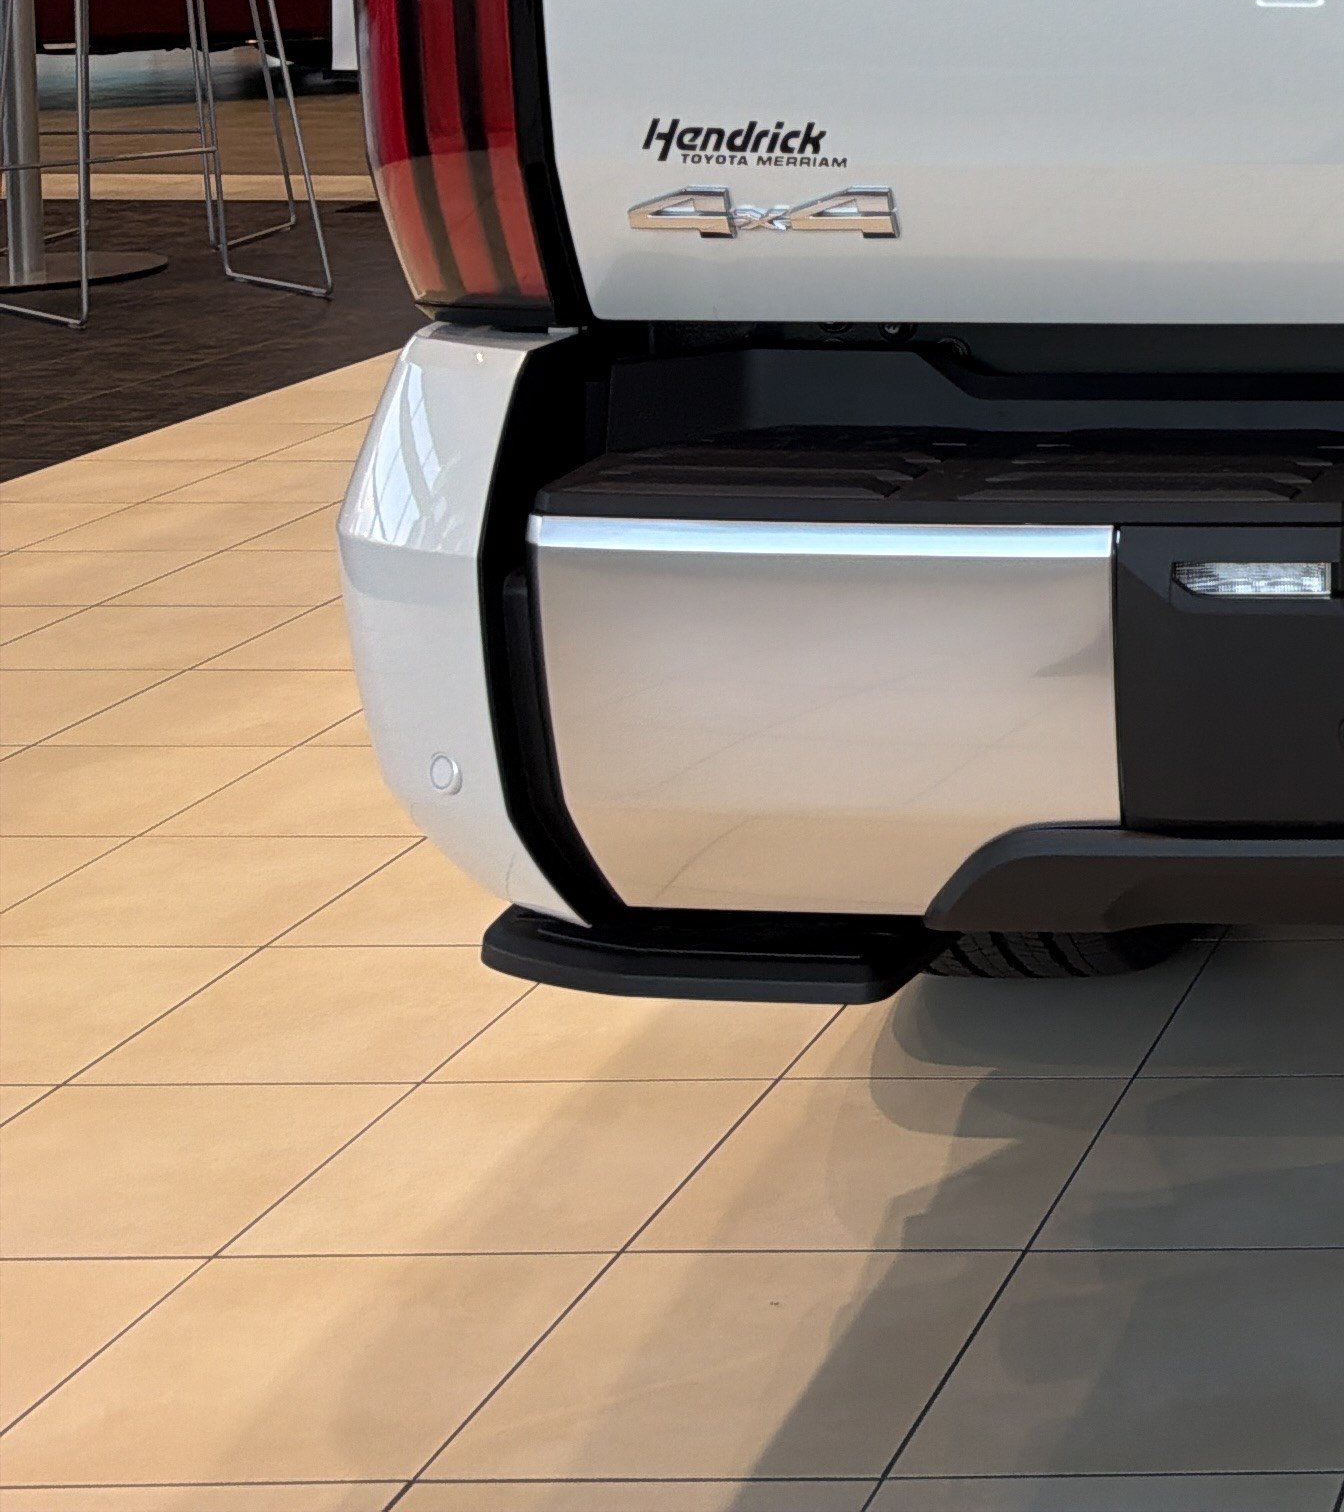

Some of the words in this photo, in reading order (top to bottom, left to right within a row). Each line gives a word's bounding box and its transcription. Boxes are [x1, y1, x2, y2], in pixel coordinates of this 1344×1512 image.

[642, 118, 827, 161] Hendrick
[681, 153, 749, 166] TOYOTA
[756, 155, 848, 168] MERRIAM
[628, 185, 902, 238] 4x4
